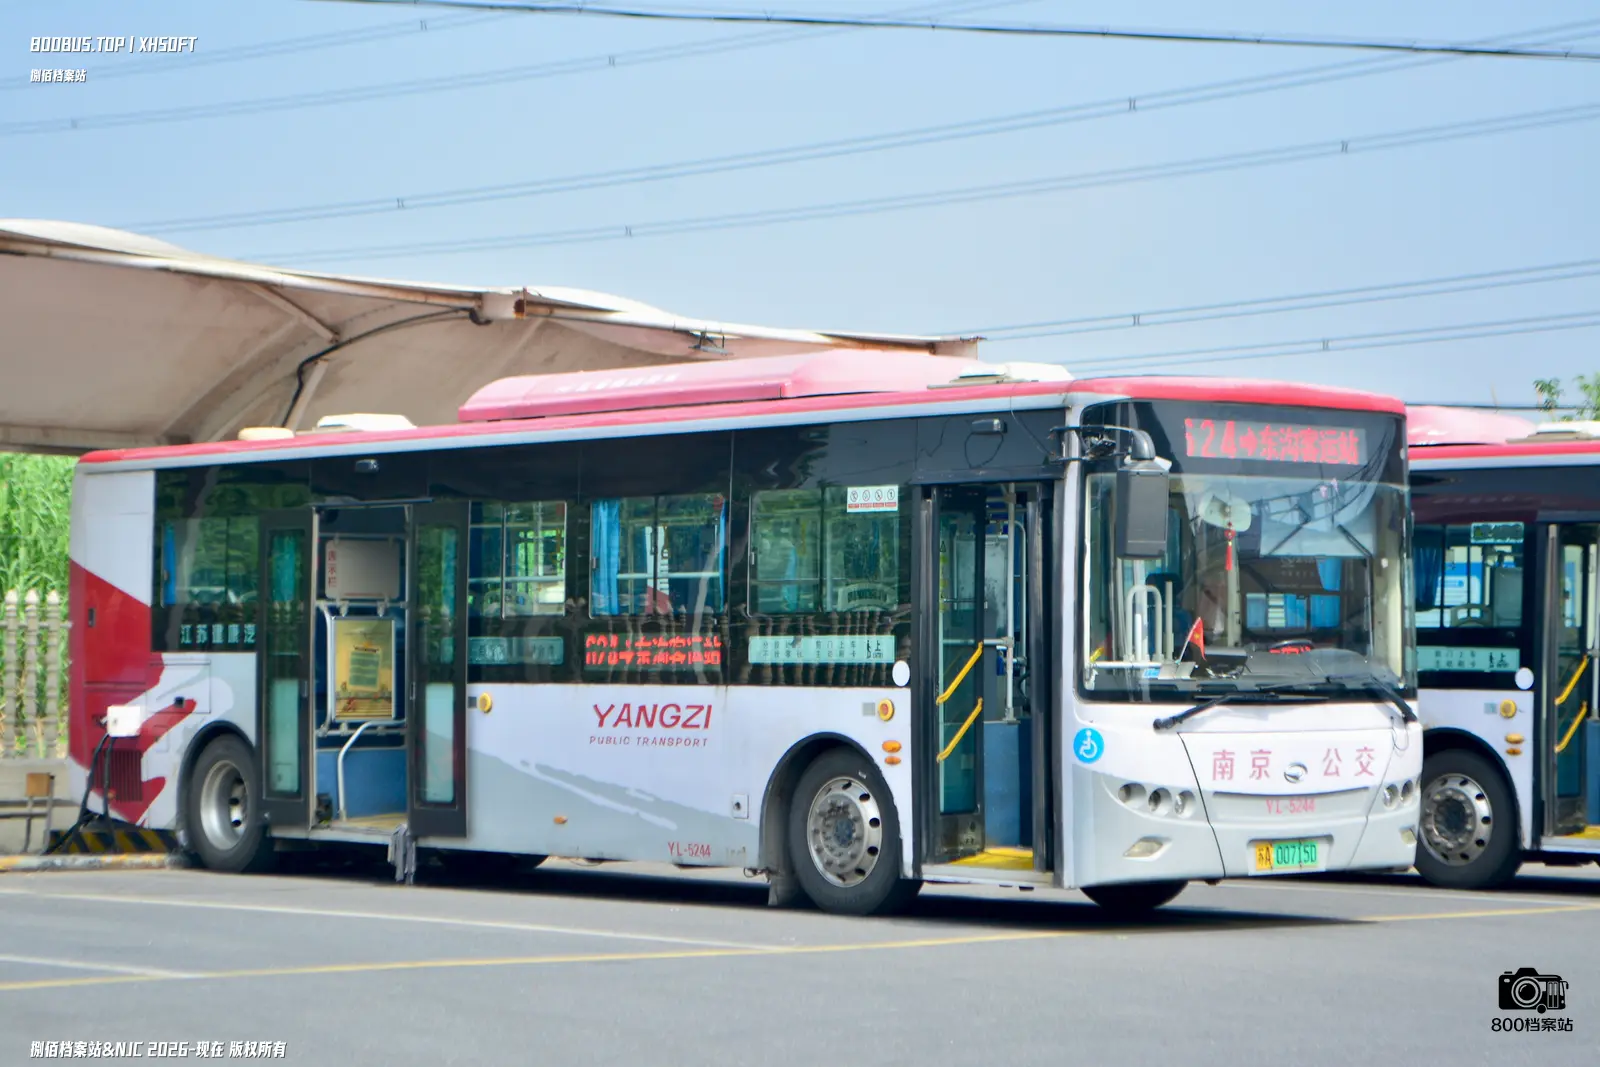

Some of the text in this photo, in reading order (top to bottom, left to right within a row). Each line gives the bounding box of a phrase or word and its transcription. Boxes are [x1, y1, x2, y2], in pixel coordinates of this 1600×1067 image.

[593, 703, 713, 729] YANGZI
[589, 735, 708, 748] PUBLIC TRANSPORT
[1212, 746, 1375, 781] 南京 公交
[1265, 797, 1316, 815] YL-5244
[668, 841, 711, 858] YL-5244
